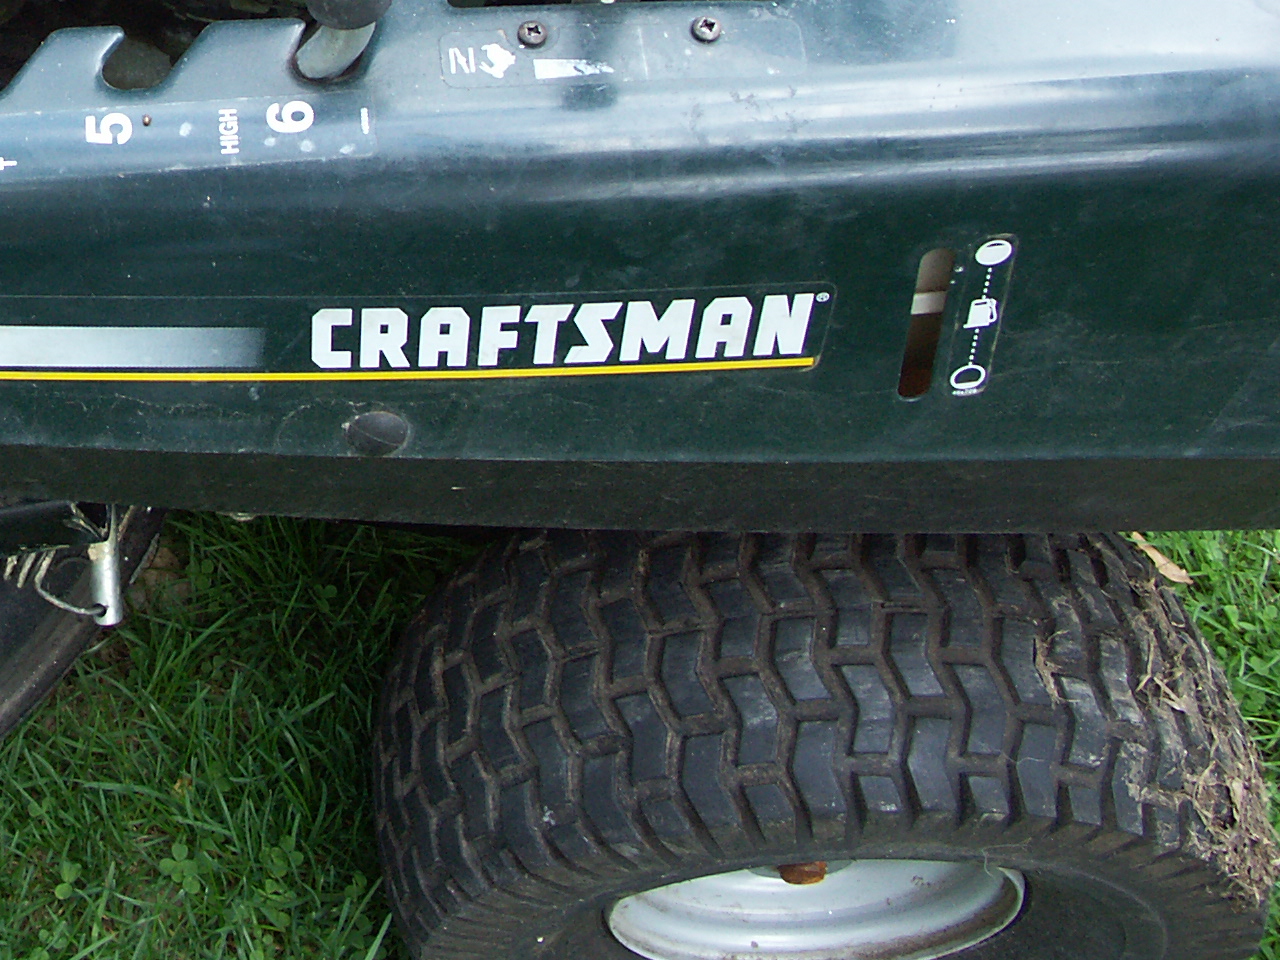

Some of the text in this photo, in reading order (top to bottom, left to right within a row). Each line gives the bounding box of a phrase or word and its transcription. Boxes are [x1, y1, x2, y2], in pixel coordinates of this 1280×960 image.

[85, 112, 133, 146] 5
[218, 108, 240, 155] HIGH
[265, 100, 315, 134] 6
[311, 291, 815, 369] CRAFTSMAN
